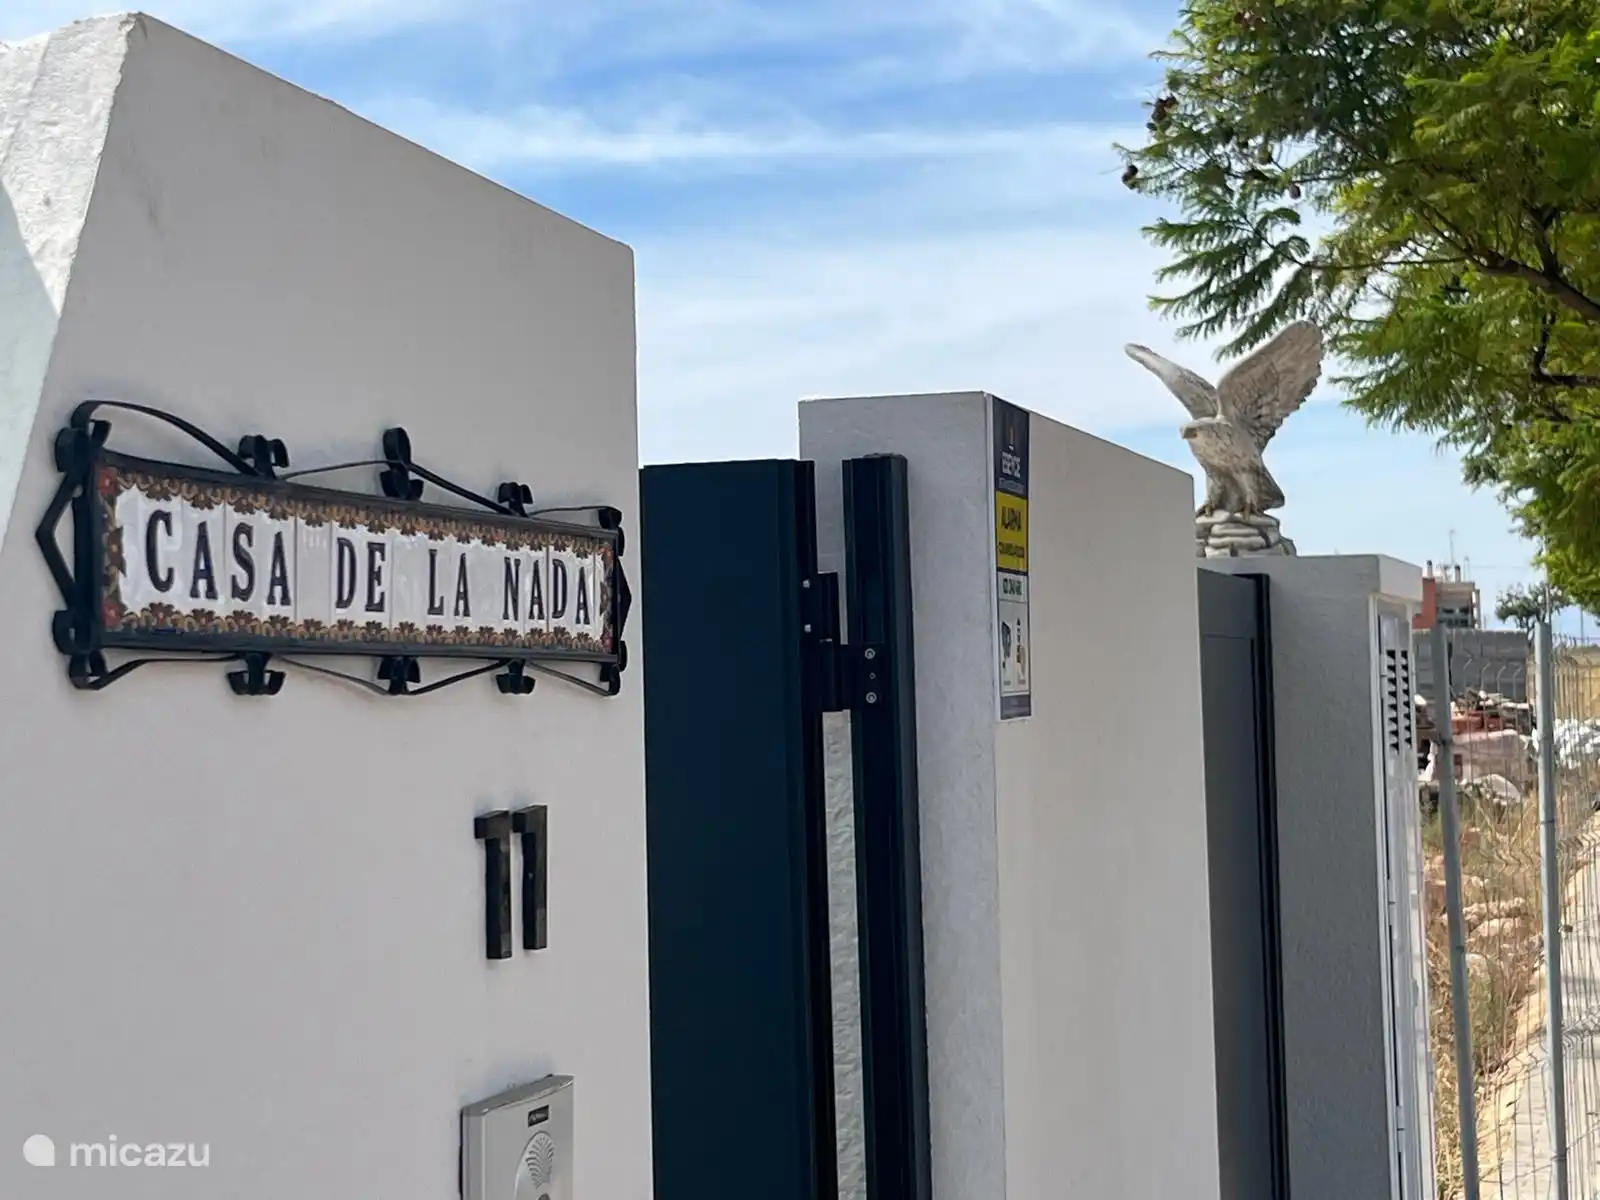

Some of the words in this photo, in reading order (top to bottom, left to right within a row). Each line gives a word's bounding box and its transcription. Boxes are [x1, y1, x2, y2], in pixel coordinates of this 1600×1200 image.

[146, 511, 291, 606] CASA
[336, 537, 385, 612] DE
[427, 549, 471, 617] LA
[503, 557, 590, 624] NADA
